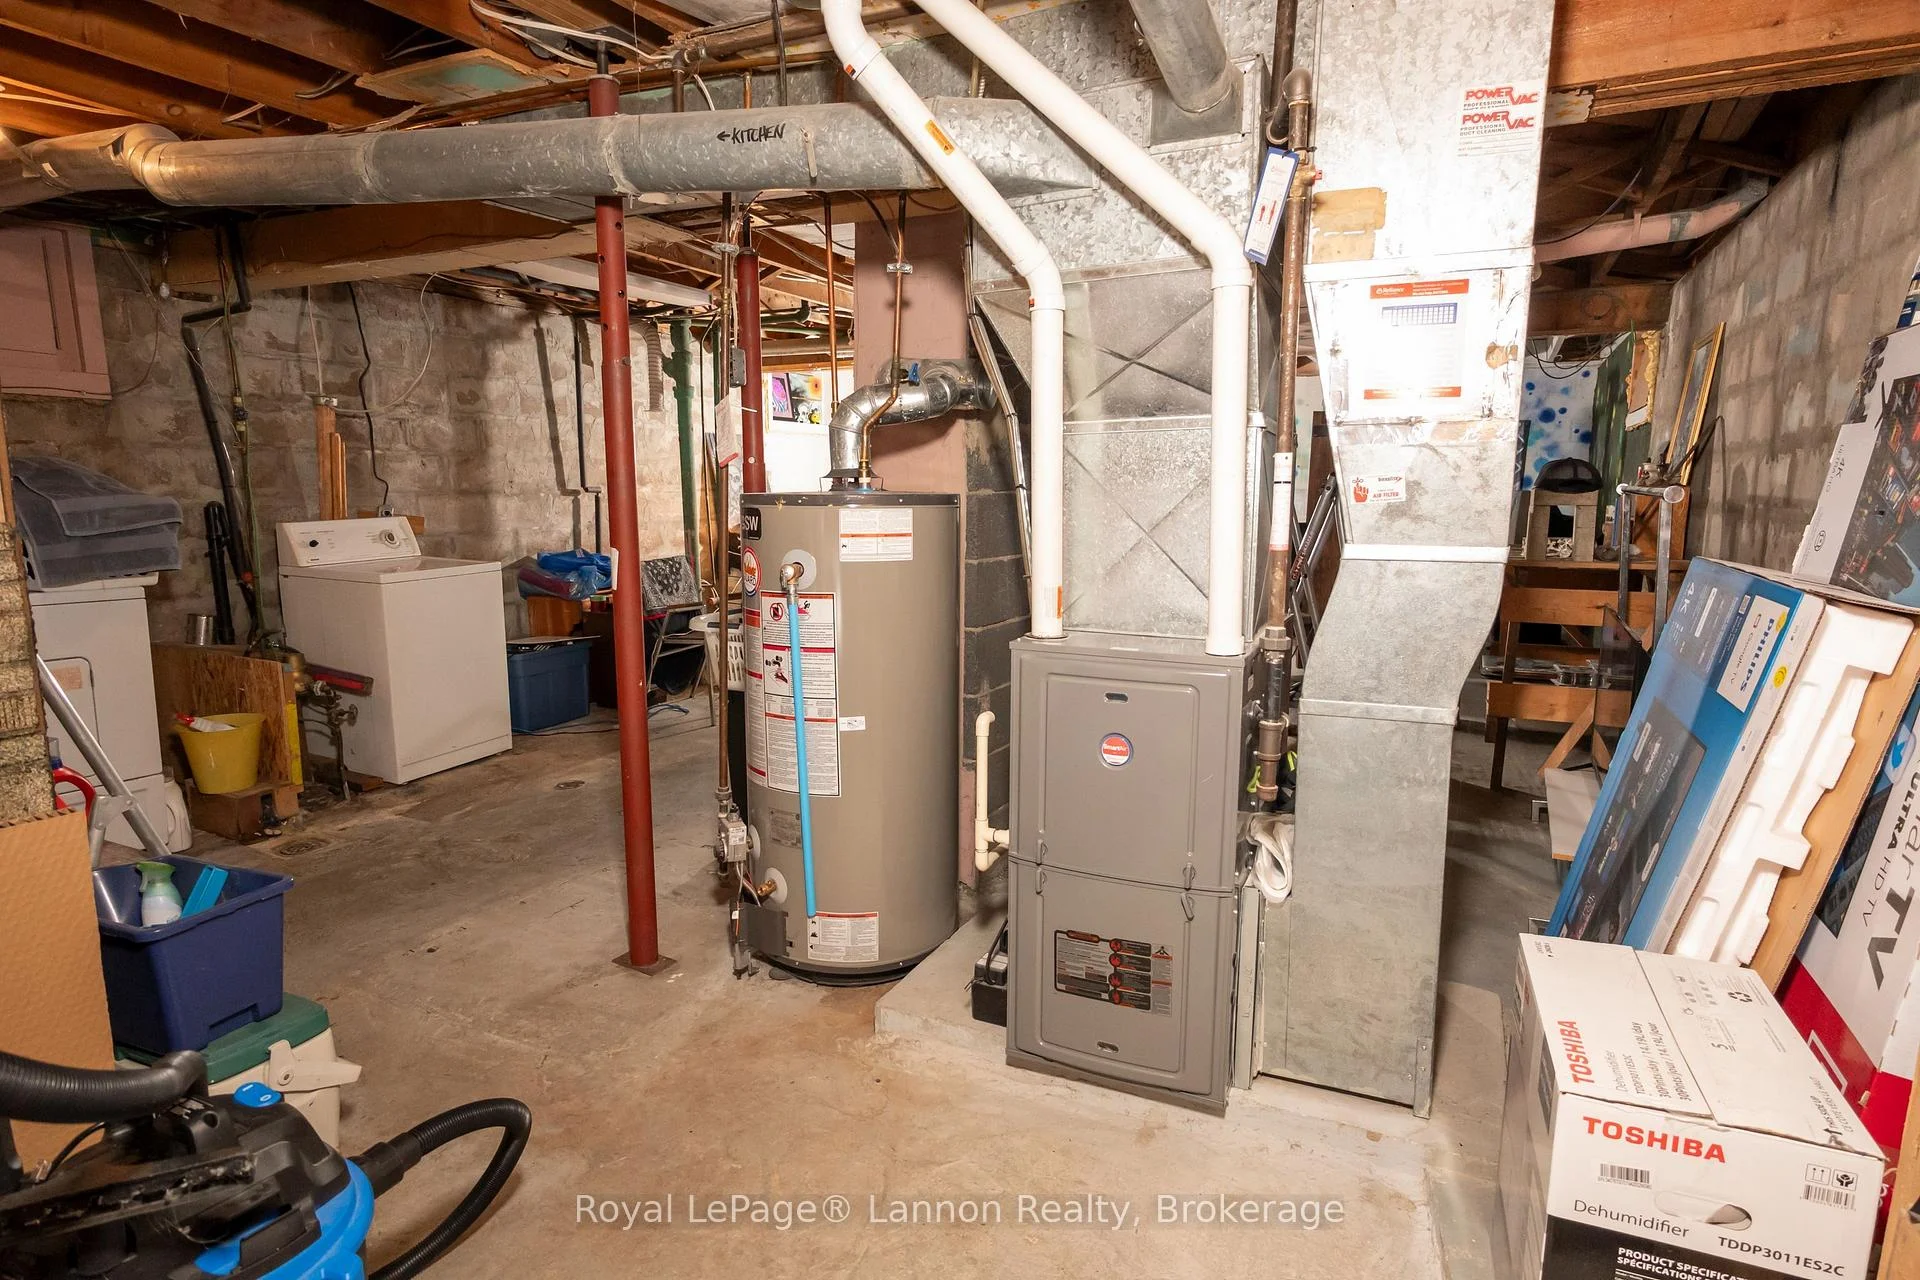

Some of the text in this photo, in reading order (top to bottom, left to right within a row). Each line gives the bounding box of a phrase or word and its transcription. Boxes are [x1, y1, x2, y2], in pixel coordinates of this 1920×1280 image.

[1466, 87, 1538, 105] POWER VAC
[731, 123, 786, 144] KITCHEN
[1462, 111, 1534, 129] POWER VAC
[1680, 582, 1695, 614] 4K
[1740, 618, 1775, 692] PHILIPS
[1874, 856, 1891, 892] HD
[1862, 899, 1875, 928] TV
[1557, 1020, 1595, 1083] TOSHIBA
[1583, 1116, 1726, 1163] TOSHIBA
[1574, 1199, 1690, 1237] Dehumidifier
[1617, 1247, 1675, 1268] PRODUCT
[1718, 1236, 1845, 1276] TDDP3011ES2C
